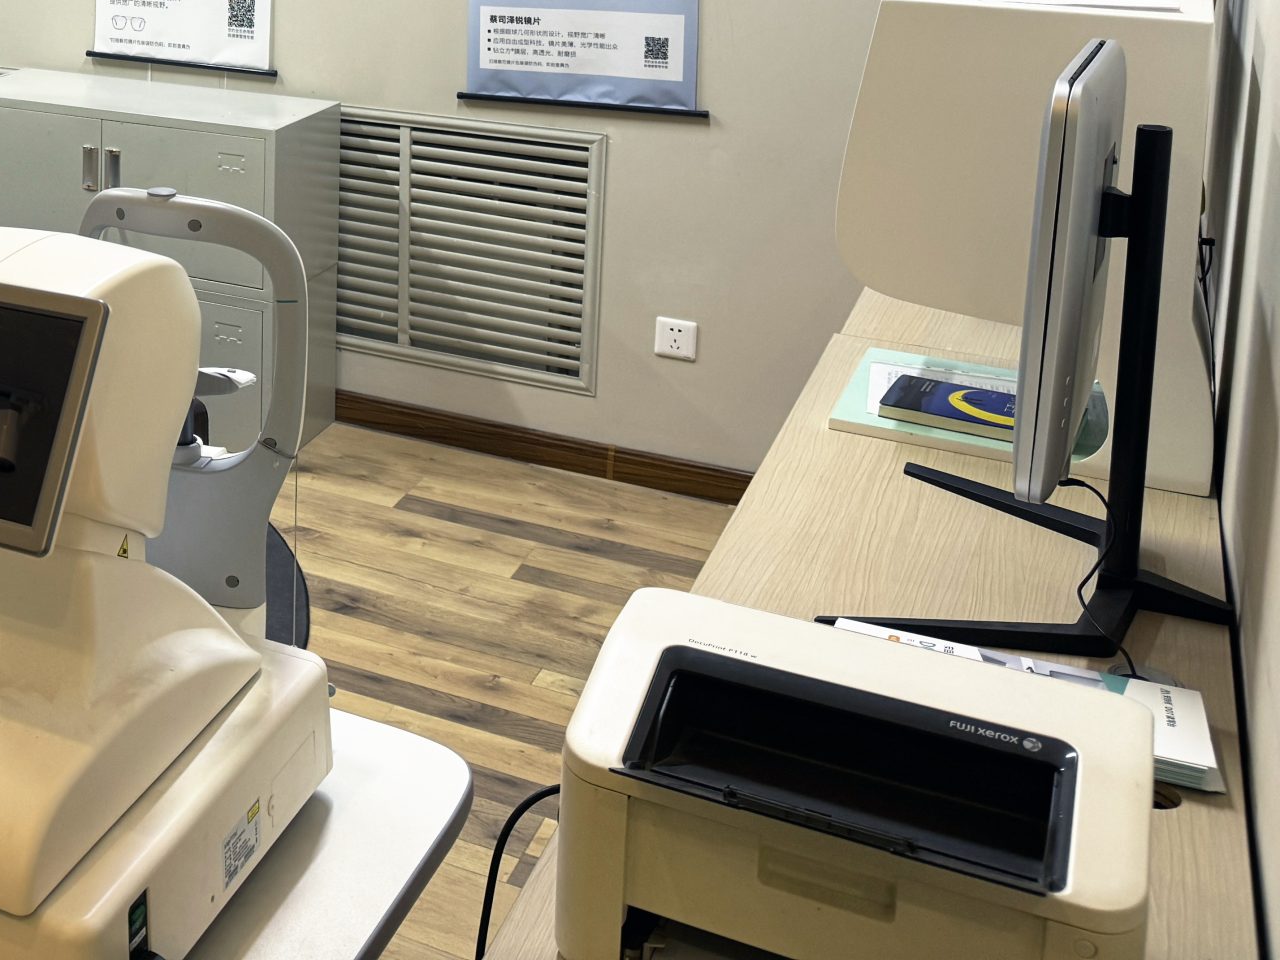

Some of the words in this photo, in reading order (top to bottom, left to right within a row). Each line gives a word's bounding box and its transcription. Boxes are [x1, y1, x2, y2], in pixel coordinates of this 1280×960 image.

[489, 14, 541, 26] 蔡司泽锐镜片
[949, 720, 975, 733] FUJI
[977, 727, 1019, 744] xerox
